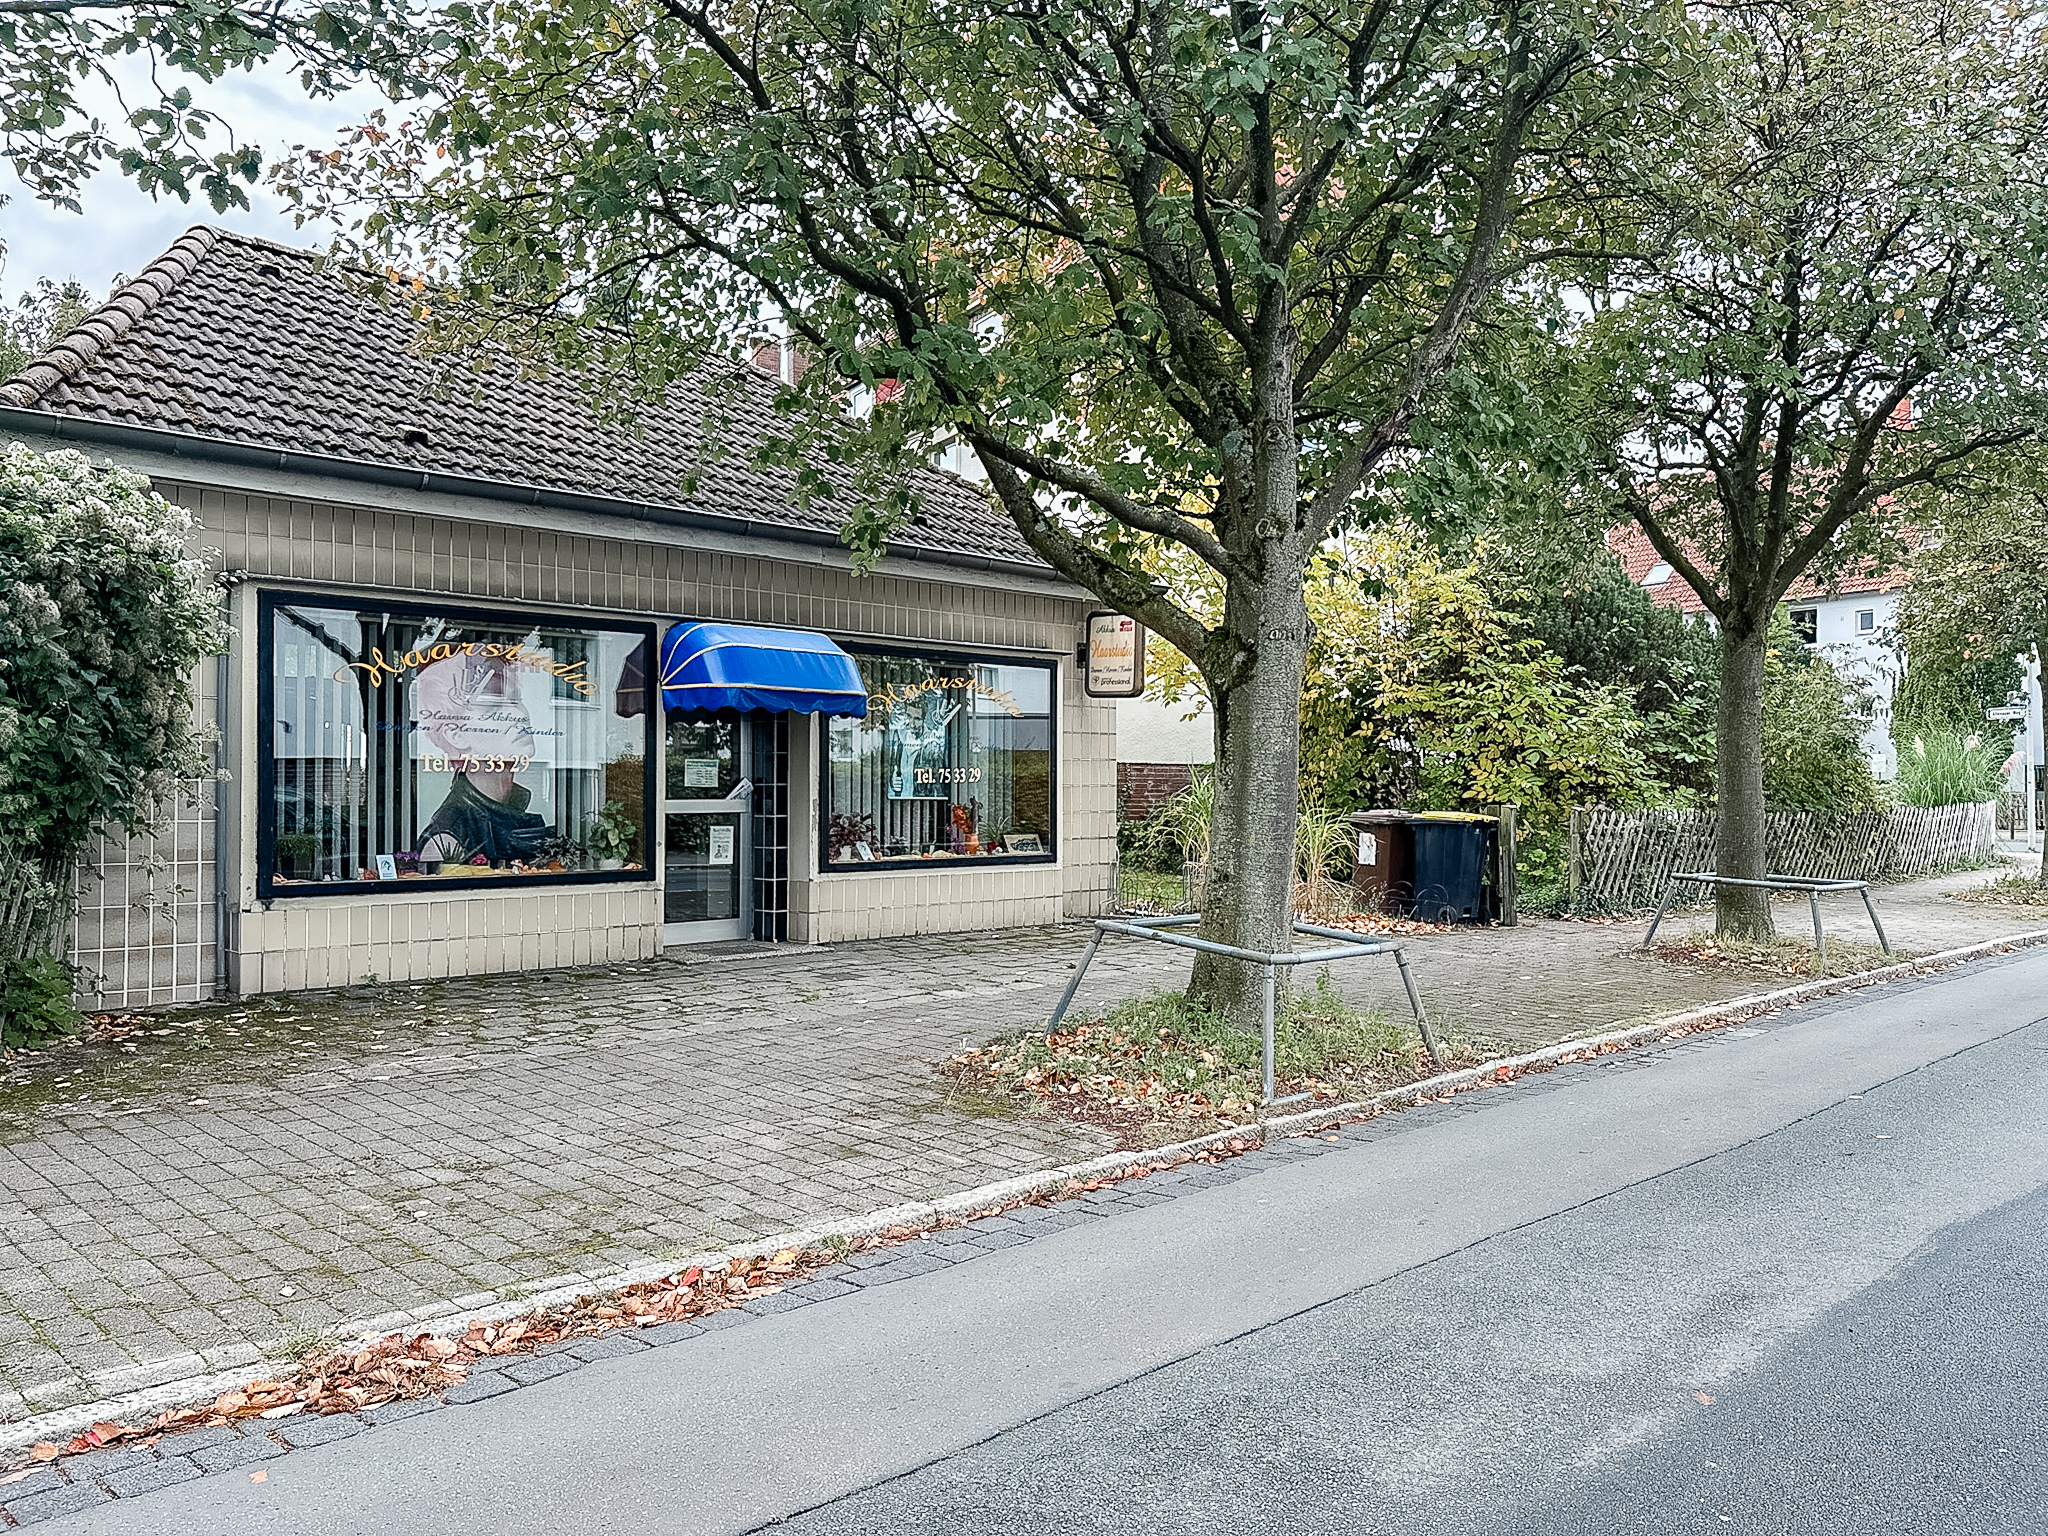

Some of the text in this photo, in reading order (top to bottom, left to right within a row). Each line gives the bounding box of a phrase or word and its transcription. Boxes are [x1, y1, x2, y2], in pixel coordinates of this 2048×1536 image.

[1091, 640, 1132, 658] Haarstudio
[333, 642, 599, 696] Haarstudio
[866, 676, 1025, 718] Haarstudio
[445, 722, 502, 734] Herren
[515, 725, 566, 737] Kinder
[419, 753, 531, 773] Tel. 75 33 29
[914, 767, 982, 784] Tel. 75 33 29
